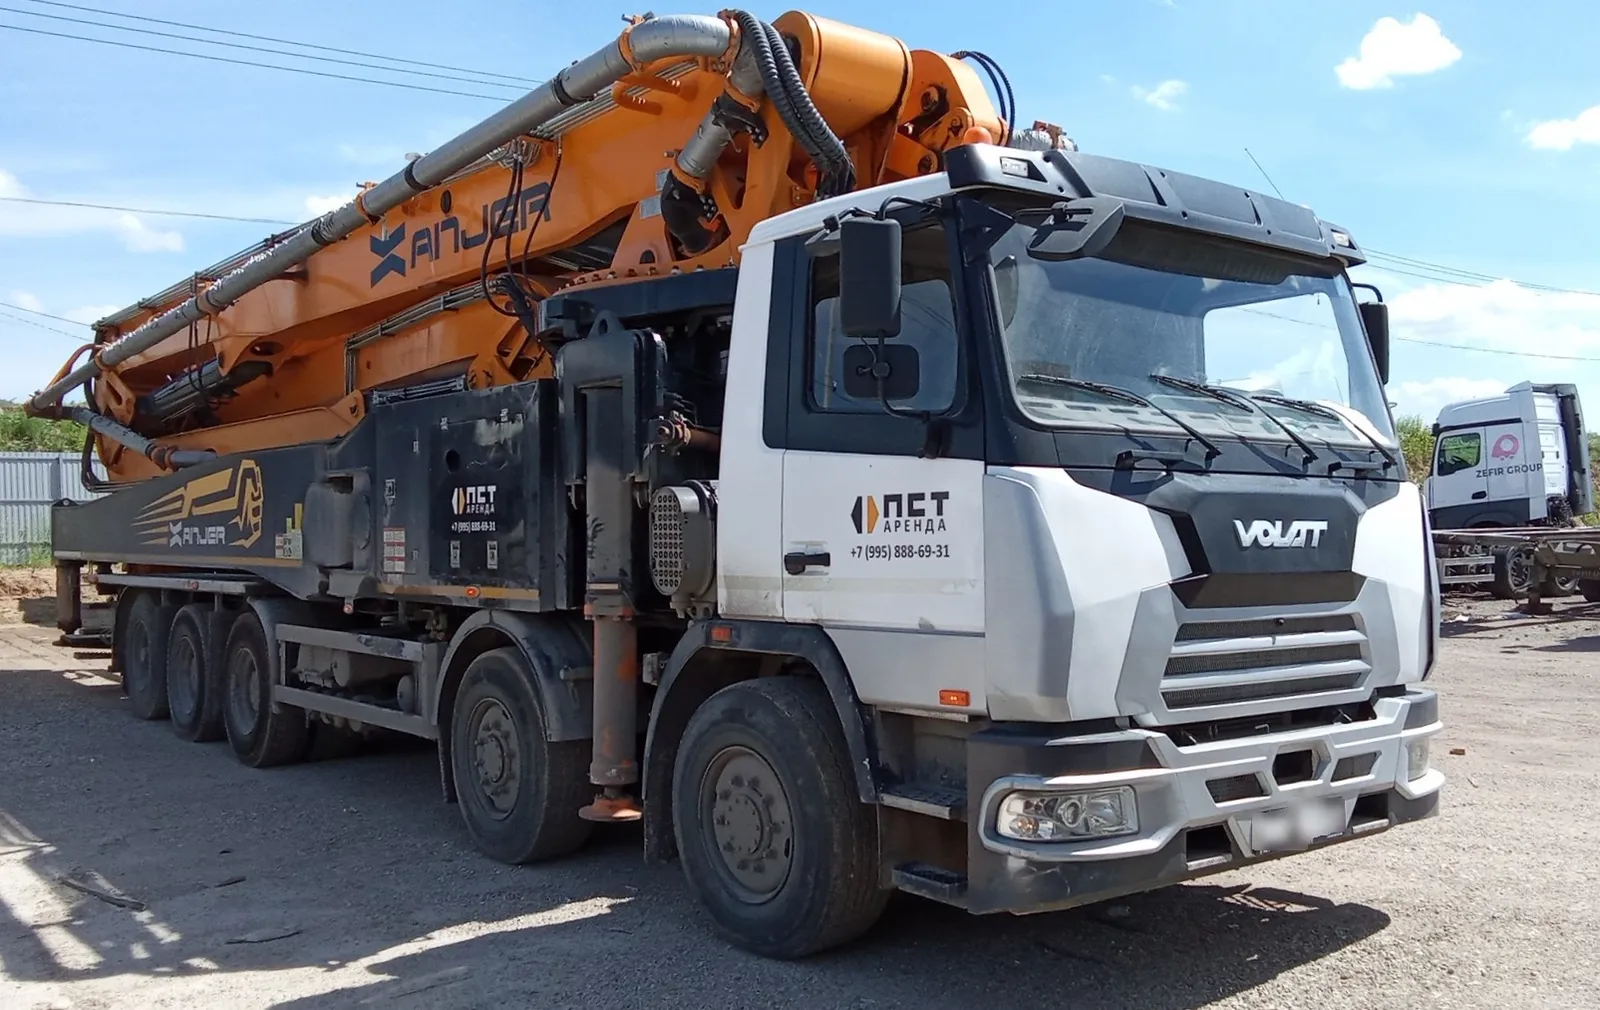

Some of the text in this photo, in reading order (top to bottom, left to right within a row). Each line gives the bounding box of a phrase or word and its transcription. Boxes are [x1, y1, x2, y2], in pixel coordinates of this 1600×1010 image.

[1476, 463, 1543, 478] ZEFIR GROUP
[466, 485, 497, 504] ПСТ
[466, 504, 495, 515] АРЕНДА
[883, 491, 949, 518] ПСТ
[451, 522, 458, 531] +7
[884, 518, 946, 534] АРЕНДА
[851, 544, 950, 561] +7 (995) 888-69-31
